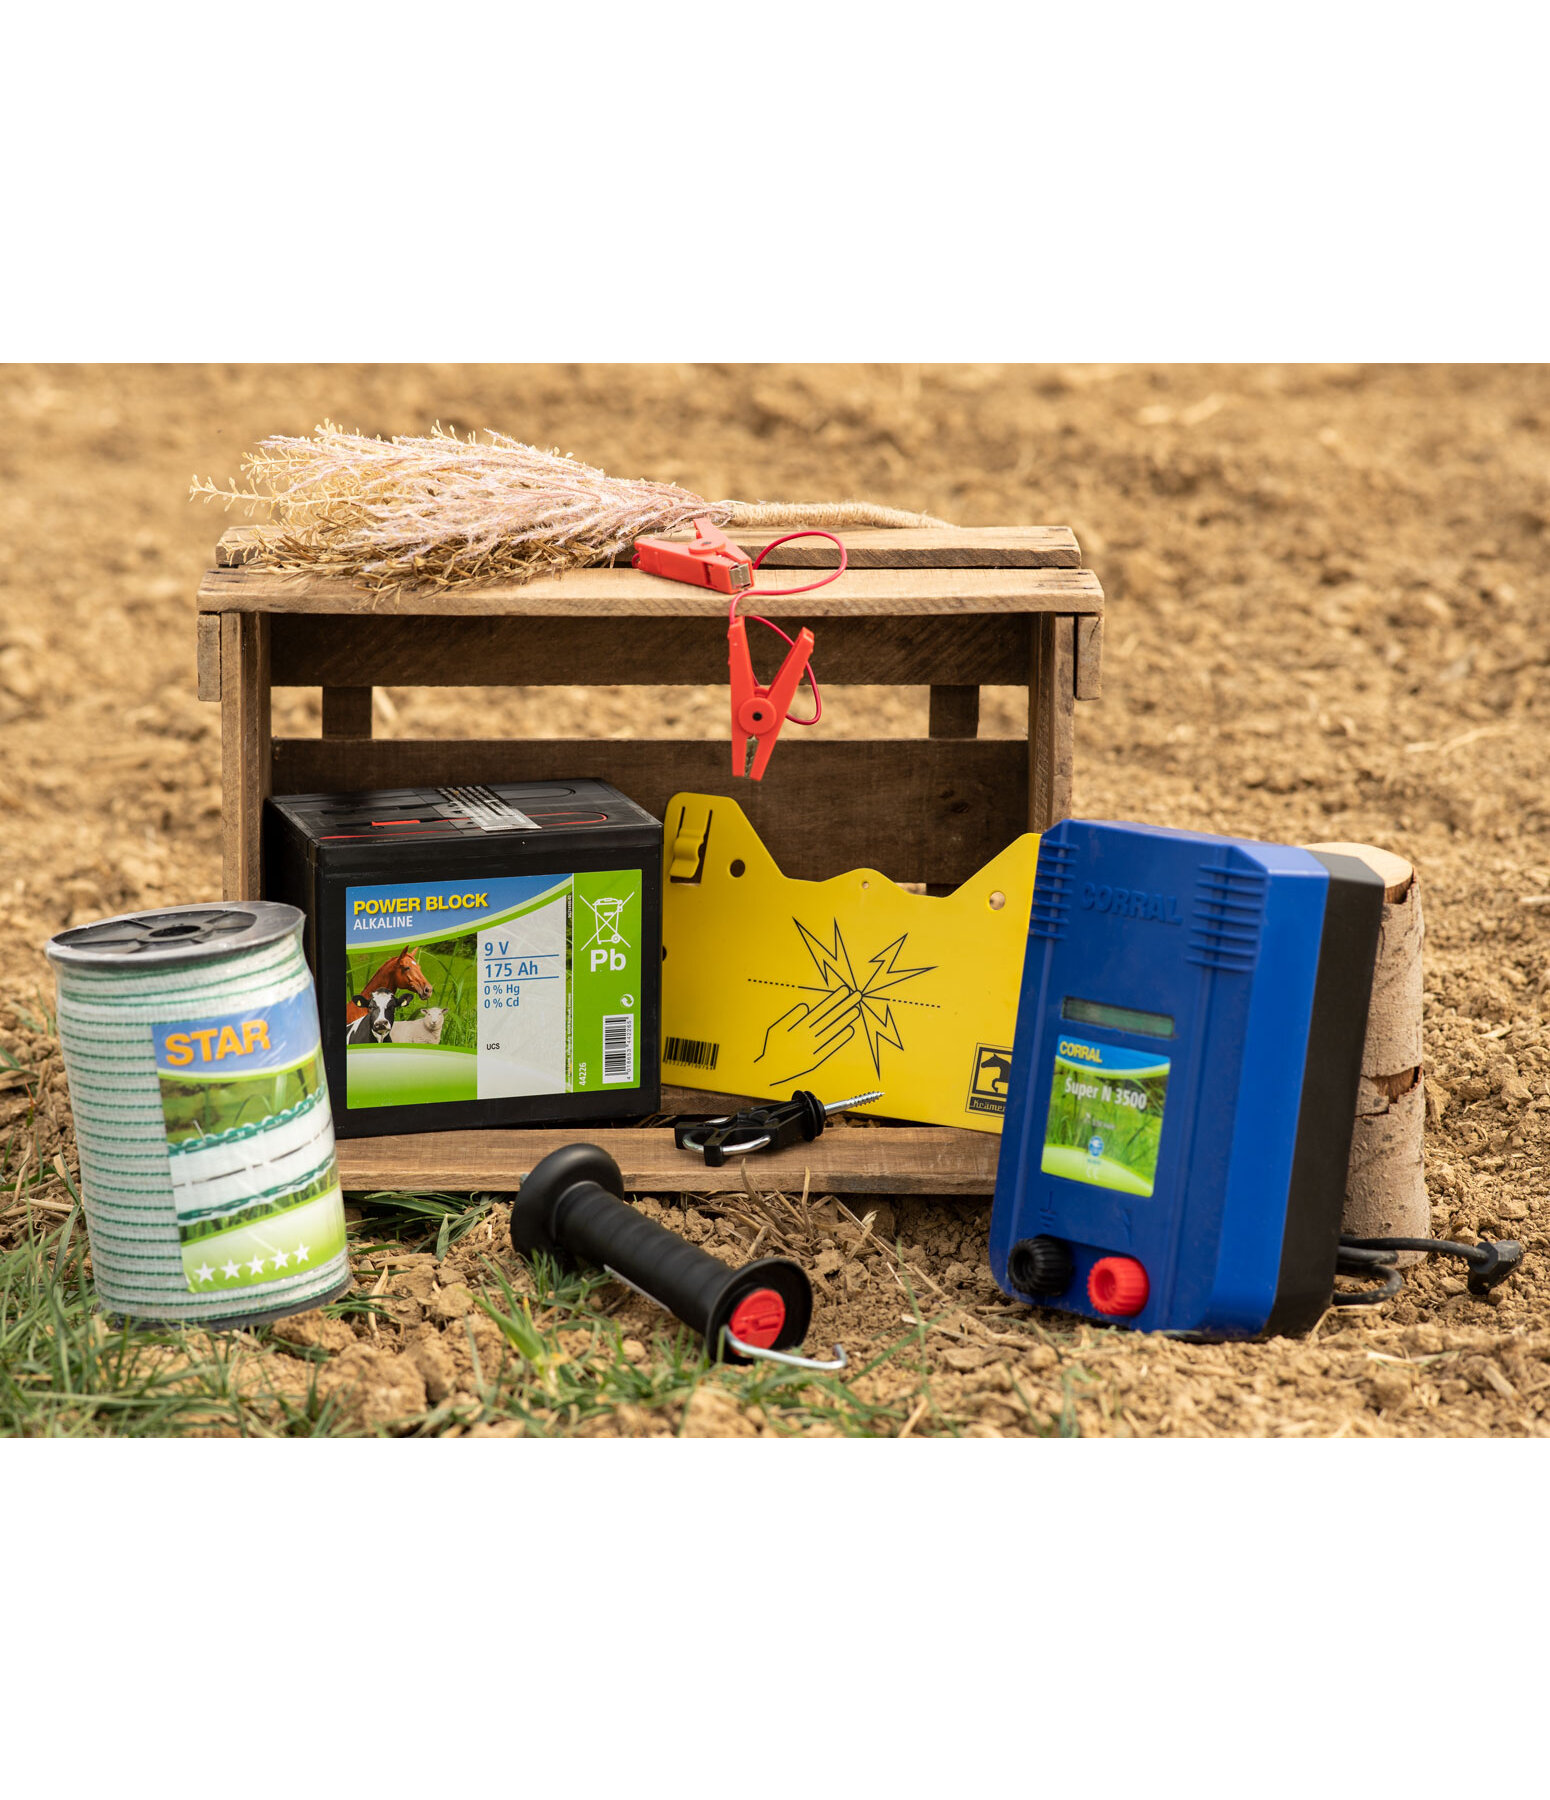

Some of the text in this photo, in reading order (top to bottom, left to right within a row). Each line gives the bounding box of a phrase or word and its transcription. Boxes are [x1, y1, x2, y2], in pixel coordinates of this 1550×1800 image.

[353, 892, 488, 916] POWER BLOCK
[1081, 882, 1184, 926] CORRAL
[353, 915, 413, 931] ALKALINE
[484, 940, 509, 956] 9 V
[485, 960, 538, 978] 175 Ah
[590, 948, 626, 972] Pb
[484, 984, 520, 995] 0 % Hg
[484, 997, 519, 1008] 0 % Cd
[165, 1019, 271, 1066] STAR
[486, 1042, 500, 1050] UCS
[1059, 1041, 1103, 1063] CORRAL
[579, 1062, 587, 1086] 44226
[1065, 1077, 1147, 1110] Super N 3500
